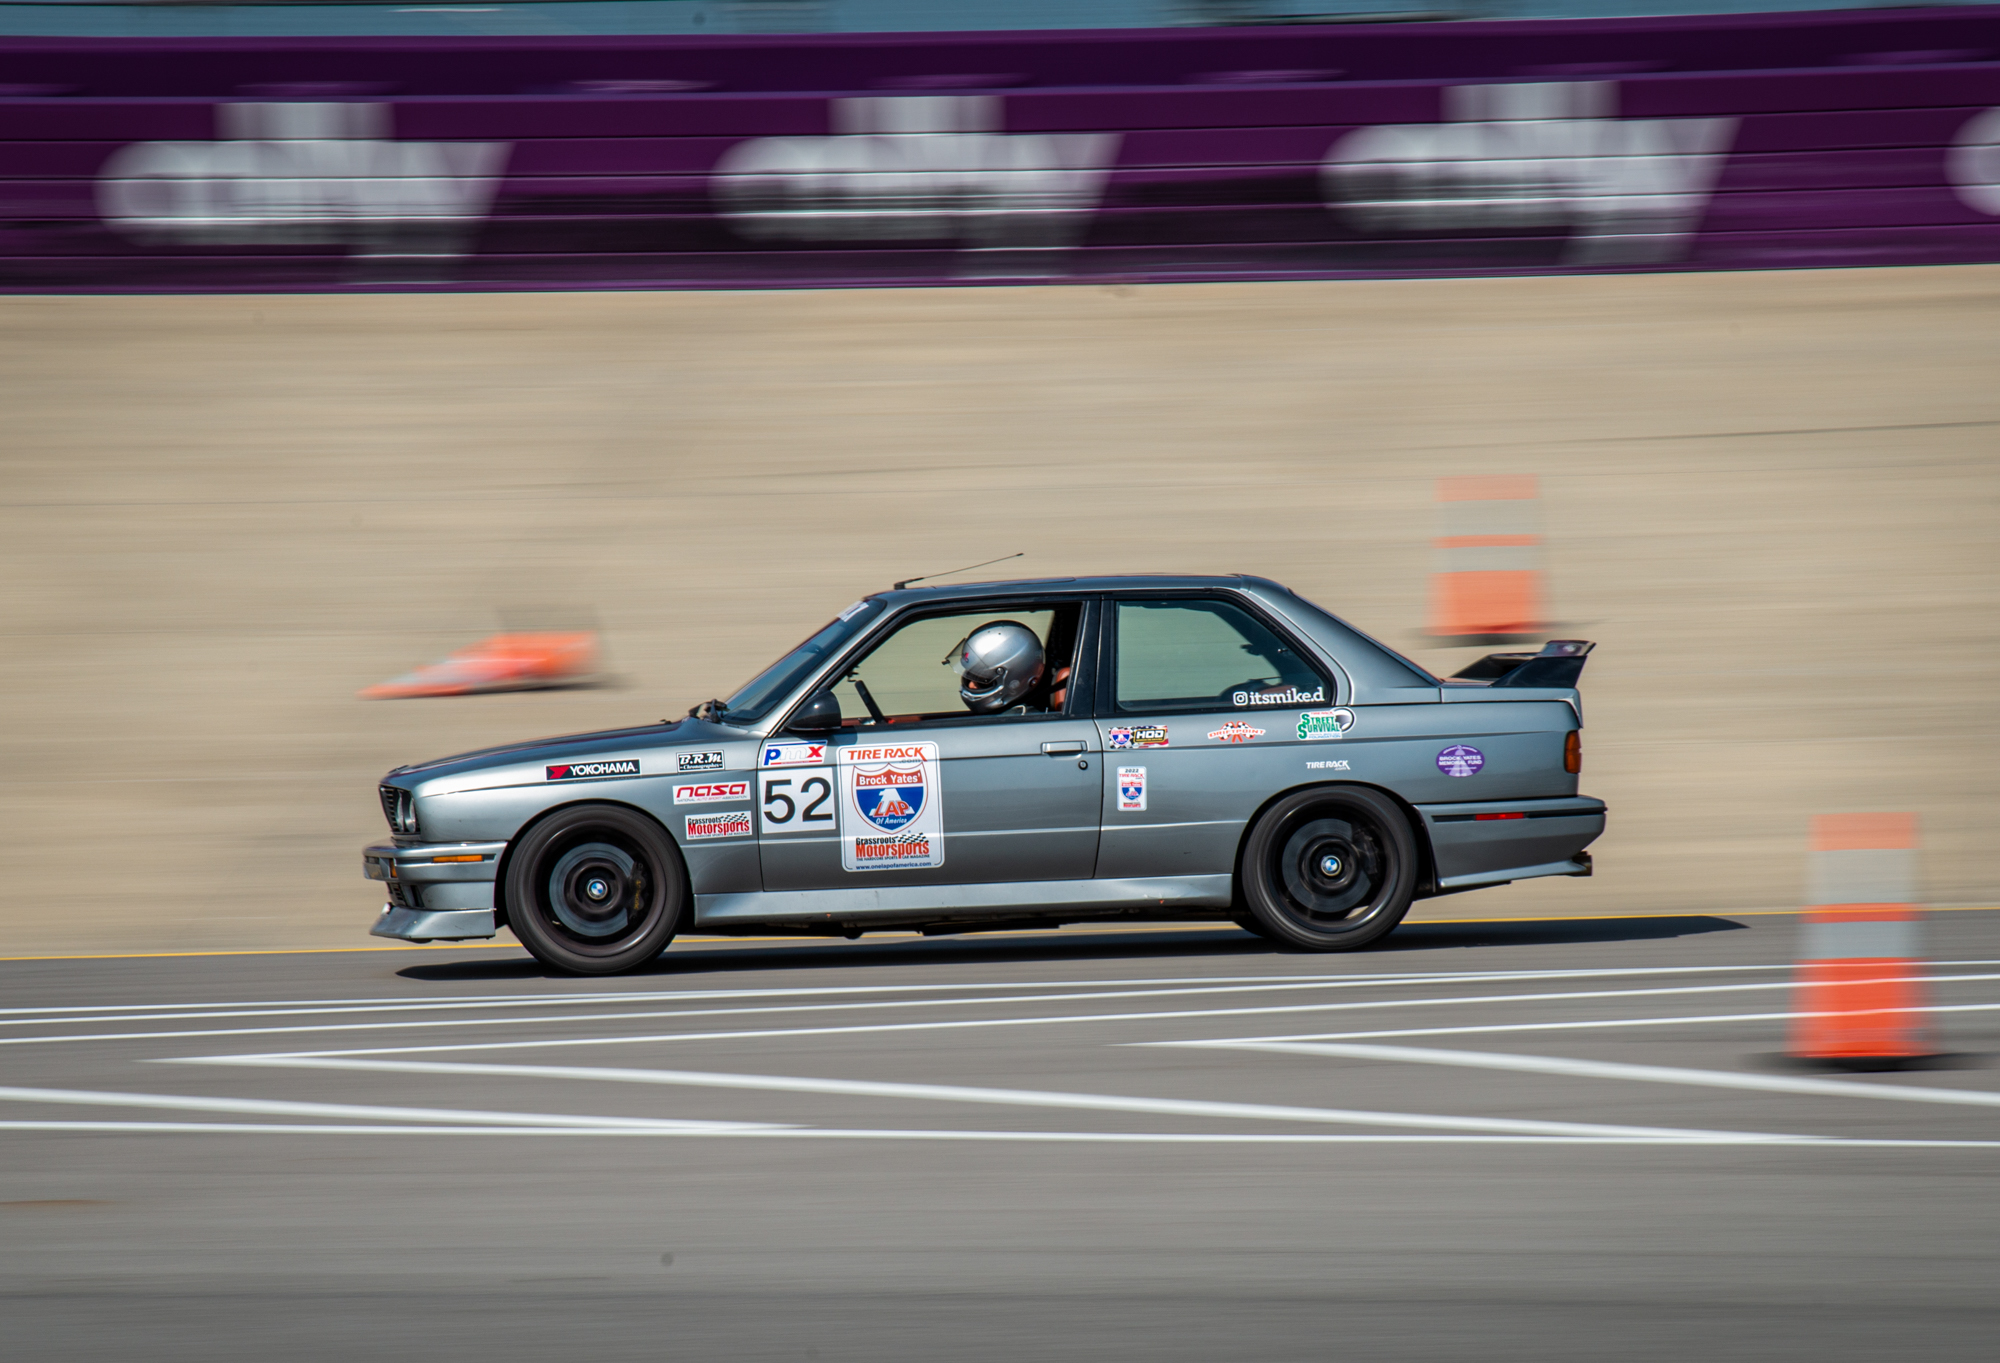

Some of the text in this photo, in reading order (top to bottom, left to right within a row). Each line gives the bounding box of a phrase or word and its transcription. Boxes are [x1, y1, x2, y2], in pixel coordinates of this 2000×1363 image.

[1250, 686, 1325, 704] itsmike.d
[1302, 714, 1334, 725] STREET
[1209, 729, 1264, 737] DRIFTPOINT
[1298, 724, 1340, 739] SURVIVAL
[848, 747, 927, 762] TIRE RACK
[570, 762, 635, 775] YOKOHAMA
[1326, 760, 1350, 770] RACK
[859, 773, 920, 785] Brock Yates'
[676, 783, 746, 798] nasa
[764, 777, 832, 824] 52
[873, 800, 909, 817] LAP
[688, 817, 721, 825] Grassroots
[688, 820, 749, 836] Motorsports
[856, 837, 896, 845] Grassroots
[856, 842, 929, 859] Motorsports
[856, 862, 931, 870] www.onelapofamerica.com
